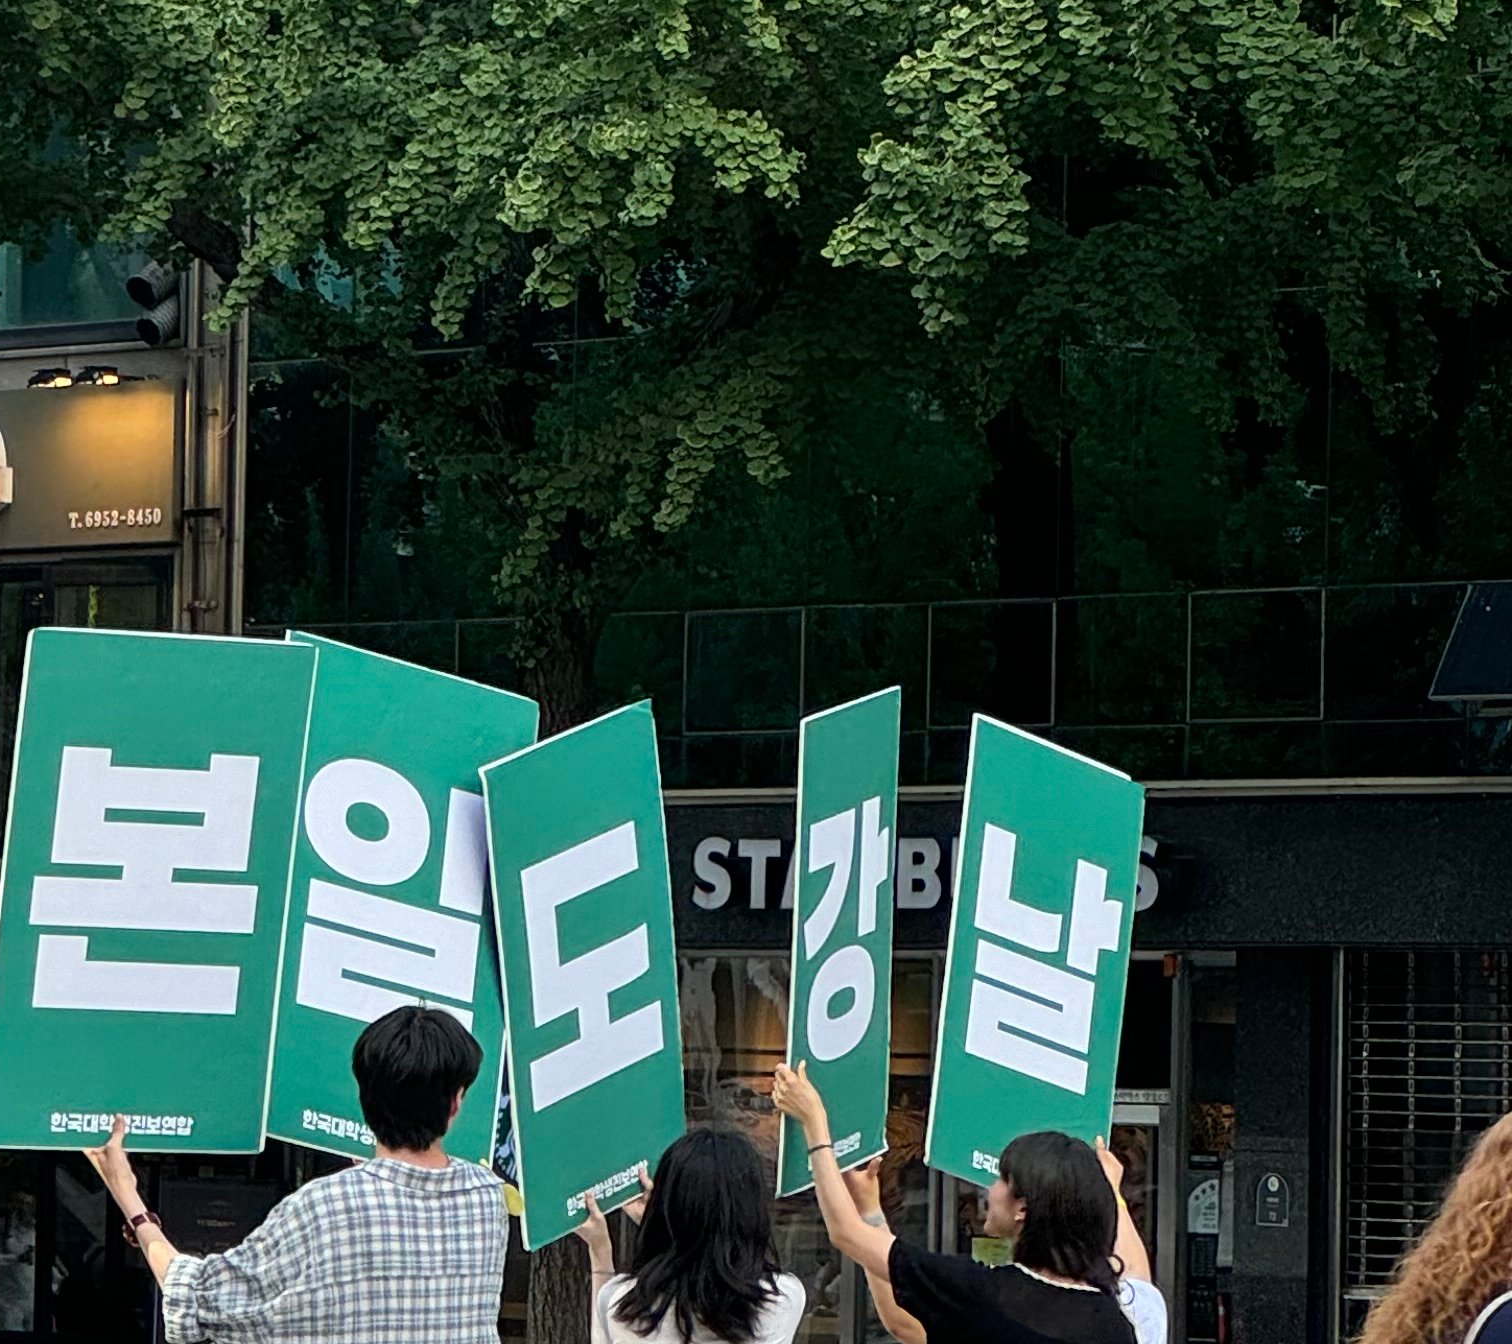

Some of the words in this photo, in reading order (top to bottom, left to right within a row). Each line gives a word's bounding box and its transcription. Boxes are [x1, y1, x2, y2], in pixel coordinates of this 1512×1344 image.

[30, 746, 261, 1015] 본
[297, 758, 485, 1033] 일
[521, 820, 664, 1112] 도
[803, 795, 890, 1062] 강
[965, 822, 1123, 1095] 날
